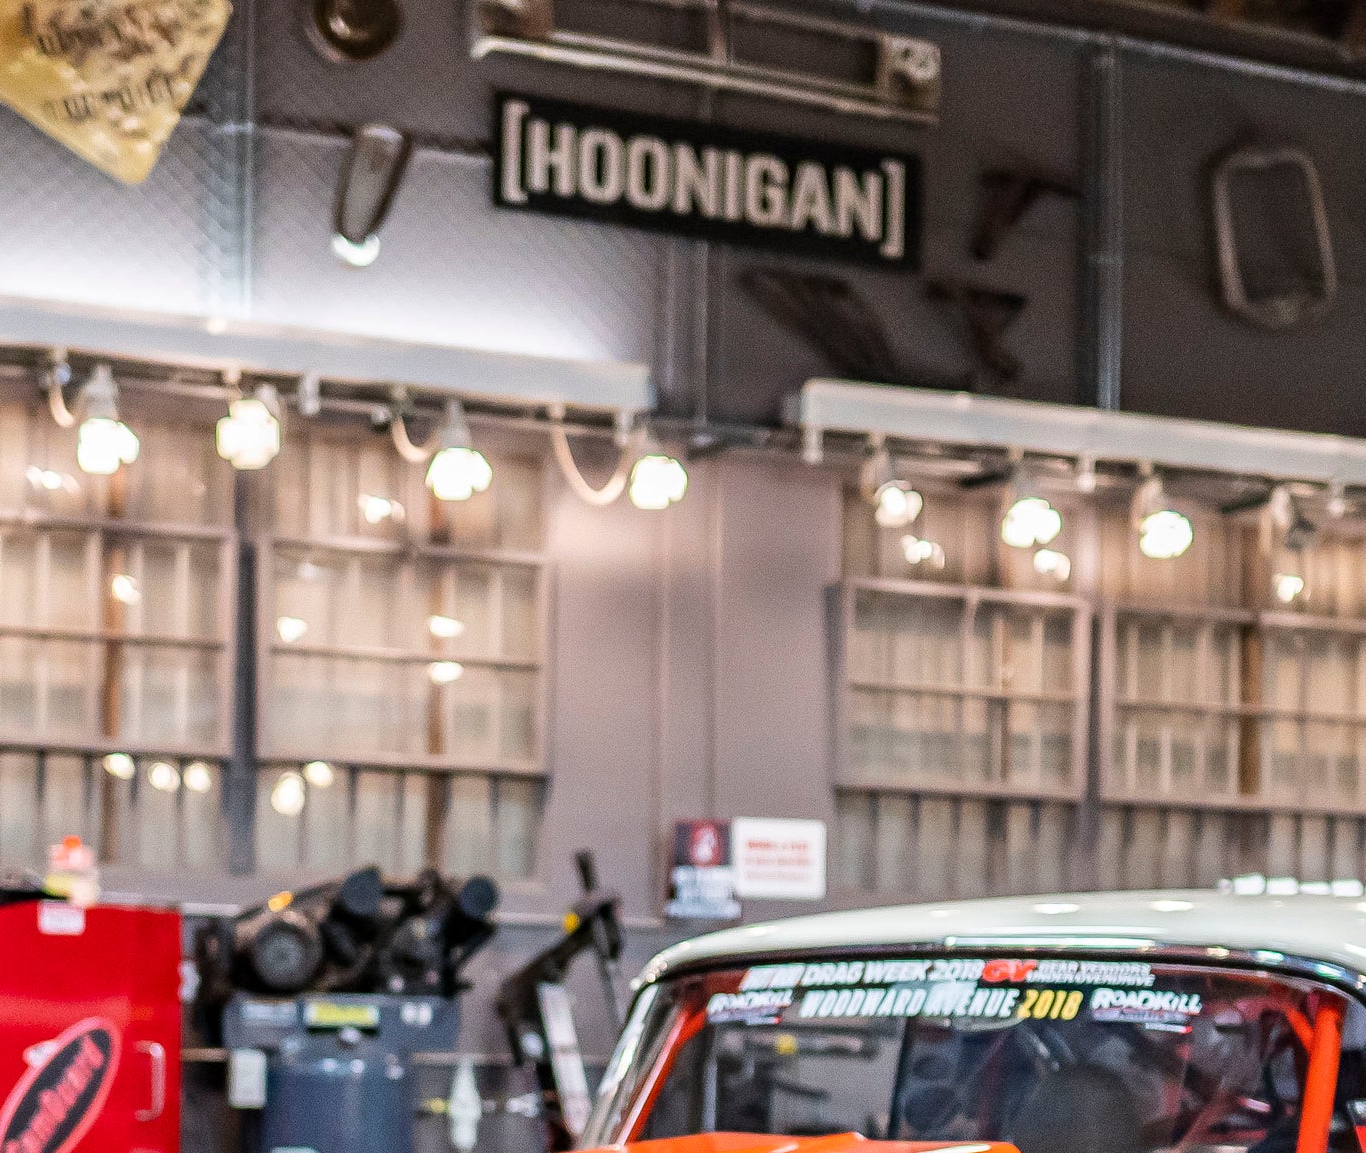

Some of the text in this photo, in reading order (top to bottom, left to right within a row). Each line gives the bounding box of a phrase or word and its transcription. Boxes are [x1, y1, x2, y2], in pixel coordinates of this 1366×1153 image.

[502, 100, 906, 259] [HOONIGAN]
[799, 963, 865, 986] DRAG
[863, 960, 932, 984] WEEK
[800, 989, 927, 1018] WOODWARD
[1017, 988, 1084, 1021] 2018
[1091, 987, 1203, 1014] ROADKILL
